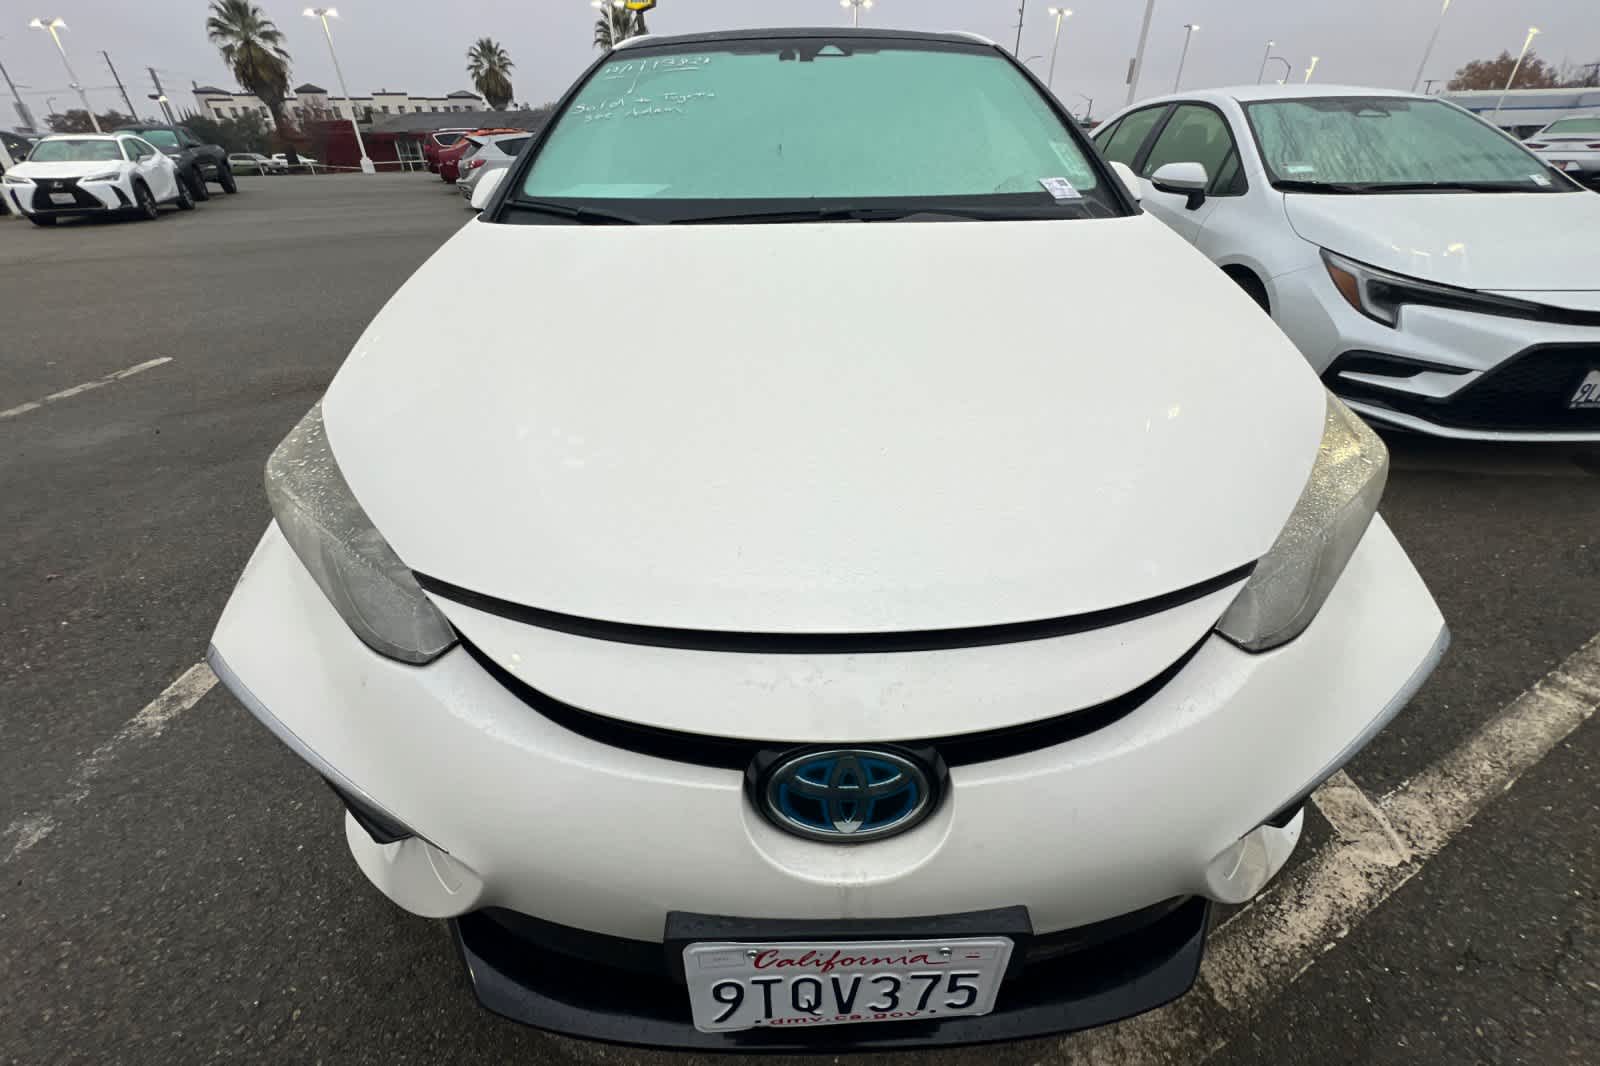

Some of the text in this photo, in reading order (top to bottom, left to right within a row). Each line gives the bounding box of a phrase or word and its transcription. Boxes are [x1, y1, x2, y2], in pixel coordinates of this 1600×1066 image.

[753, 949, 950, 973] California
[712, 972, 980, 1024] 9TQV375
[769, 1010, 921, 1026] dmv.ca.gov
